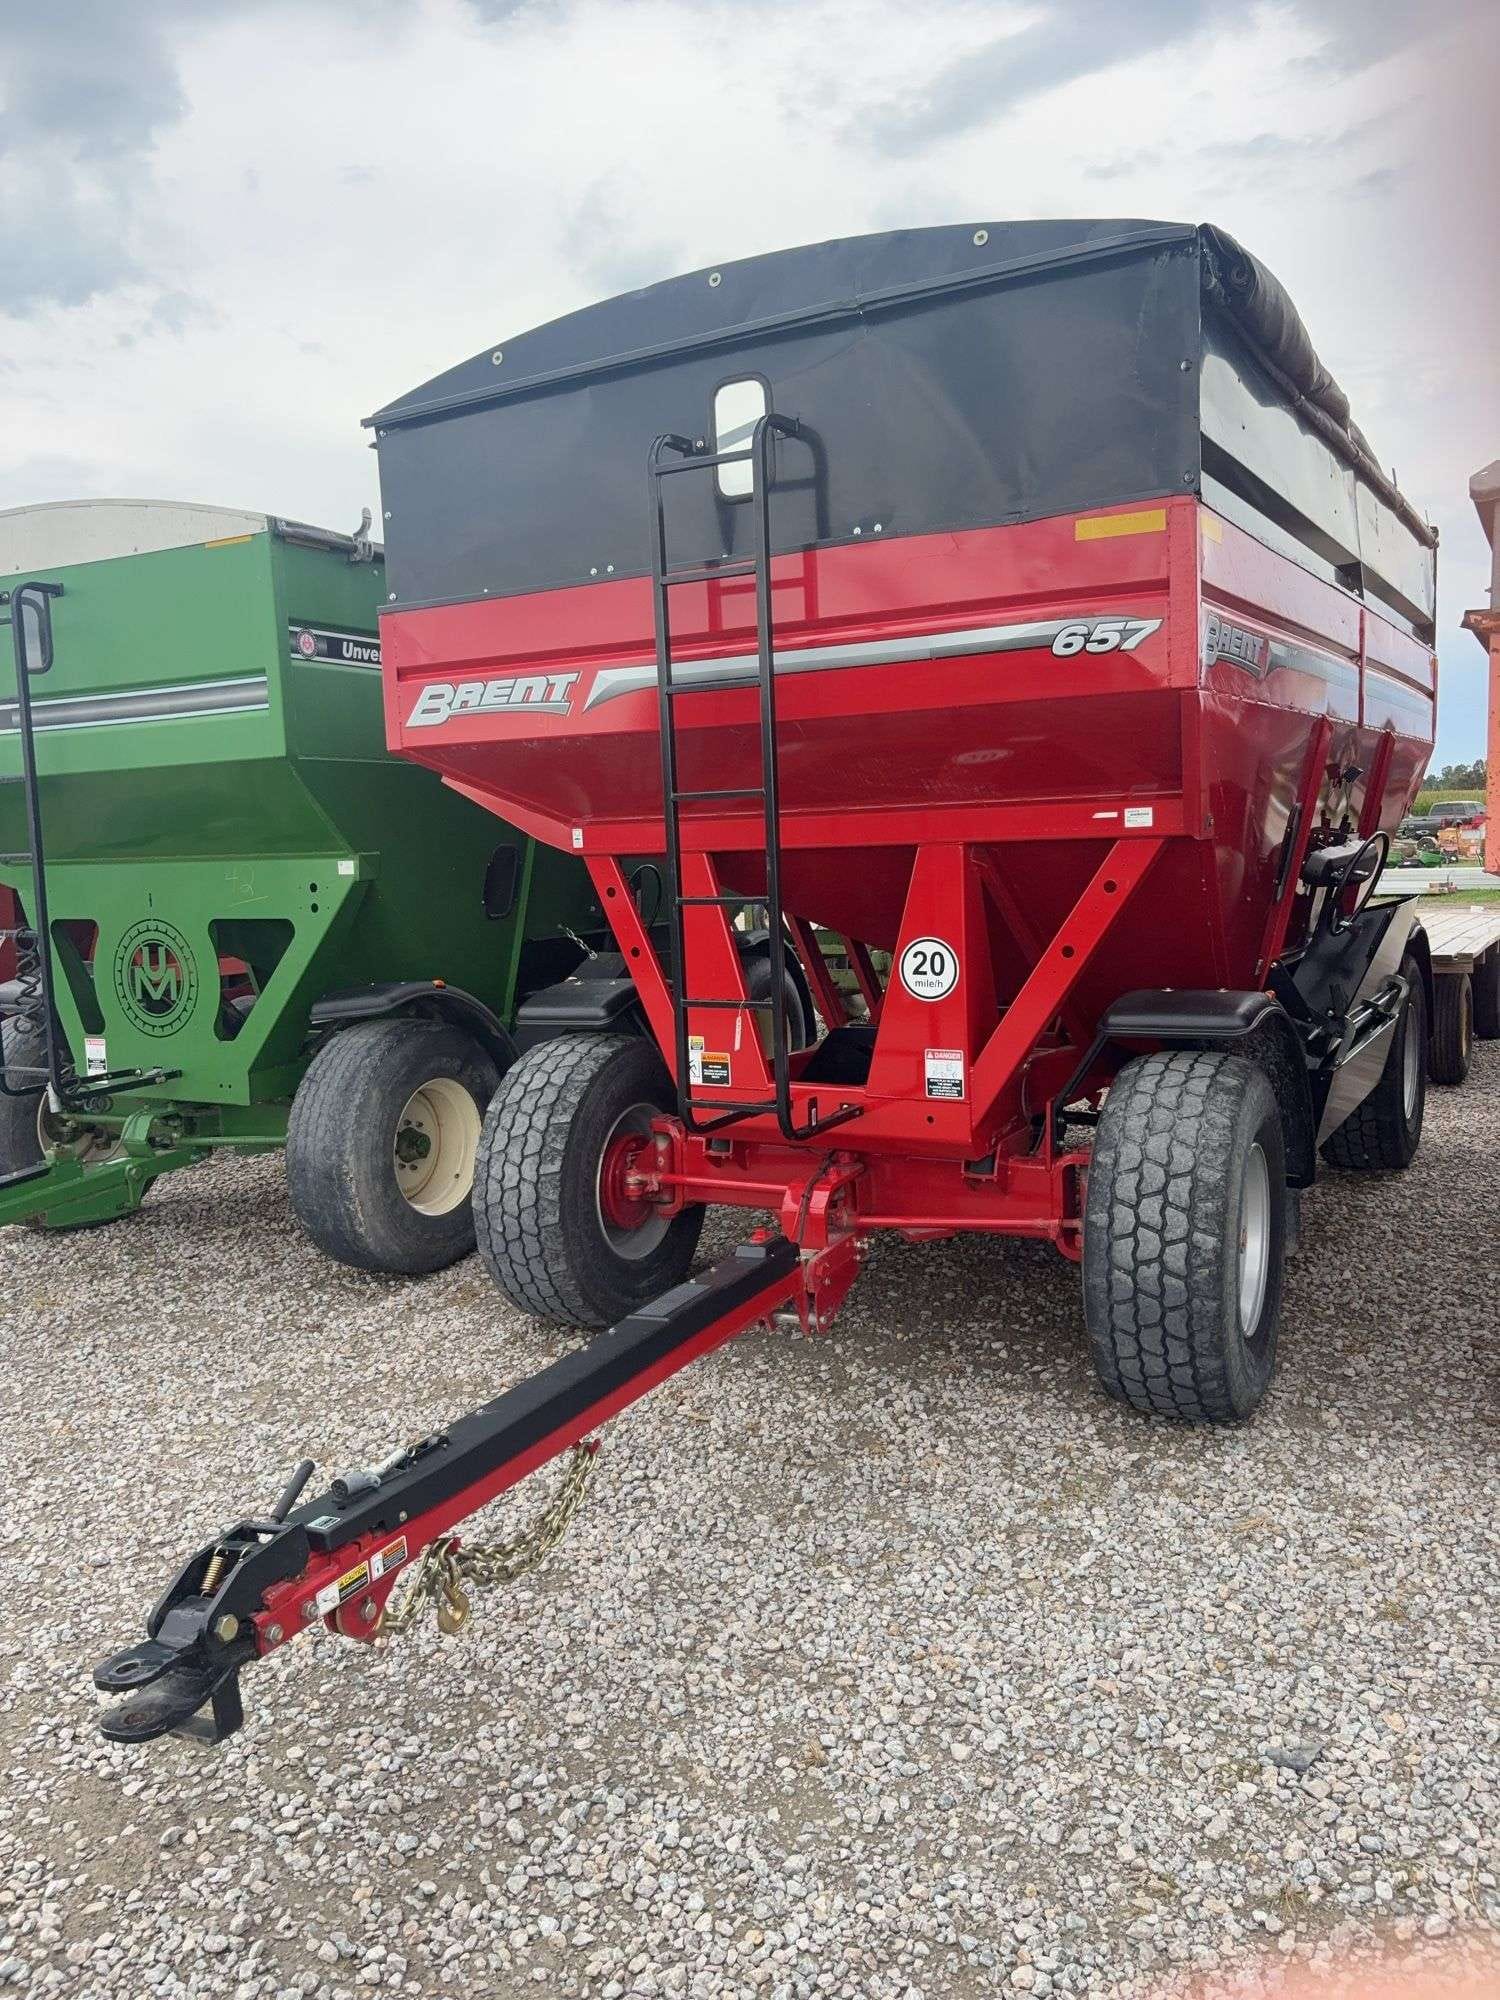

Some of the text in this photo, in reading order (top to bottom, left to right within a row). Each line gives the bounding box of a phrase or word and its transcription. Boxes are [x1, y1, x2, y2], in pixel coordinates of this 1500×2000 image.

[1052, 619, 1164, 657] 657
[1203, 613, 1266, 668] BRENT
[405, 672, 580, 727] BRENT
[912, 951, 945, 976] 20
[914, 979, 943, 988] mile/h
